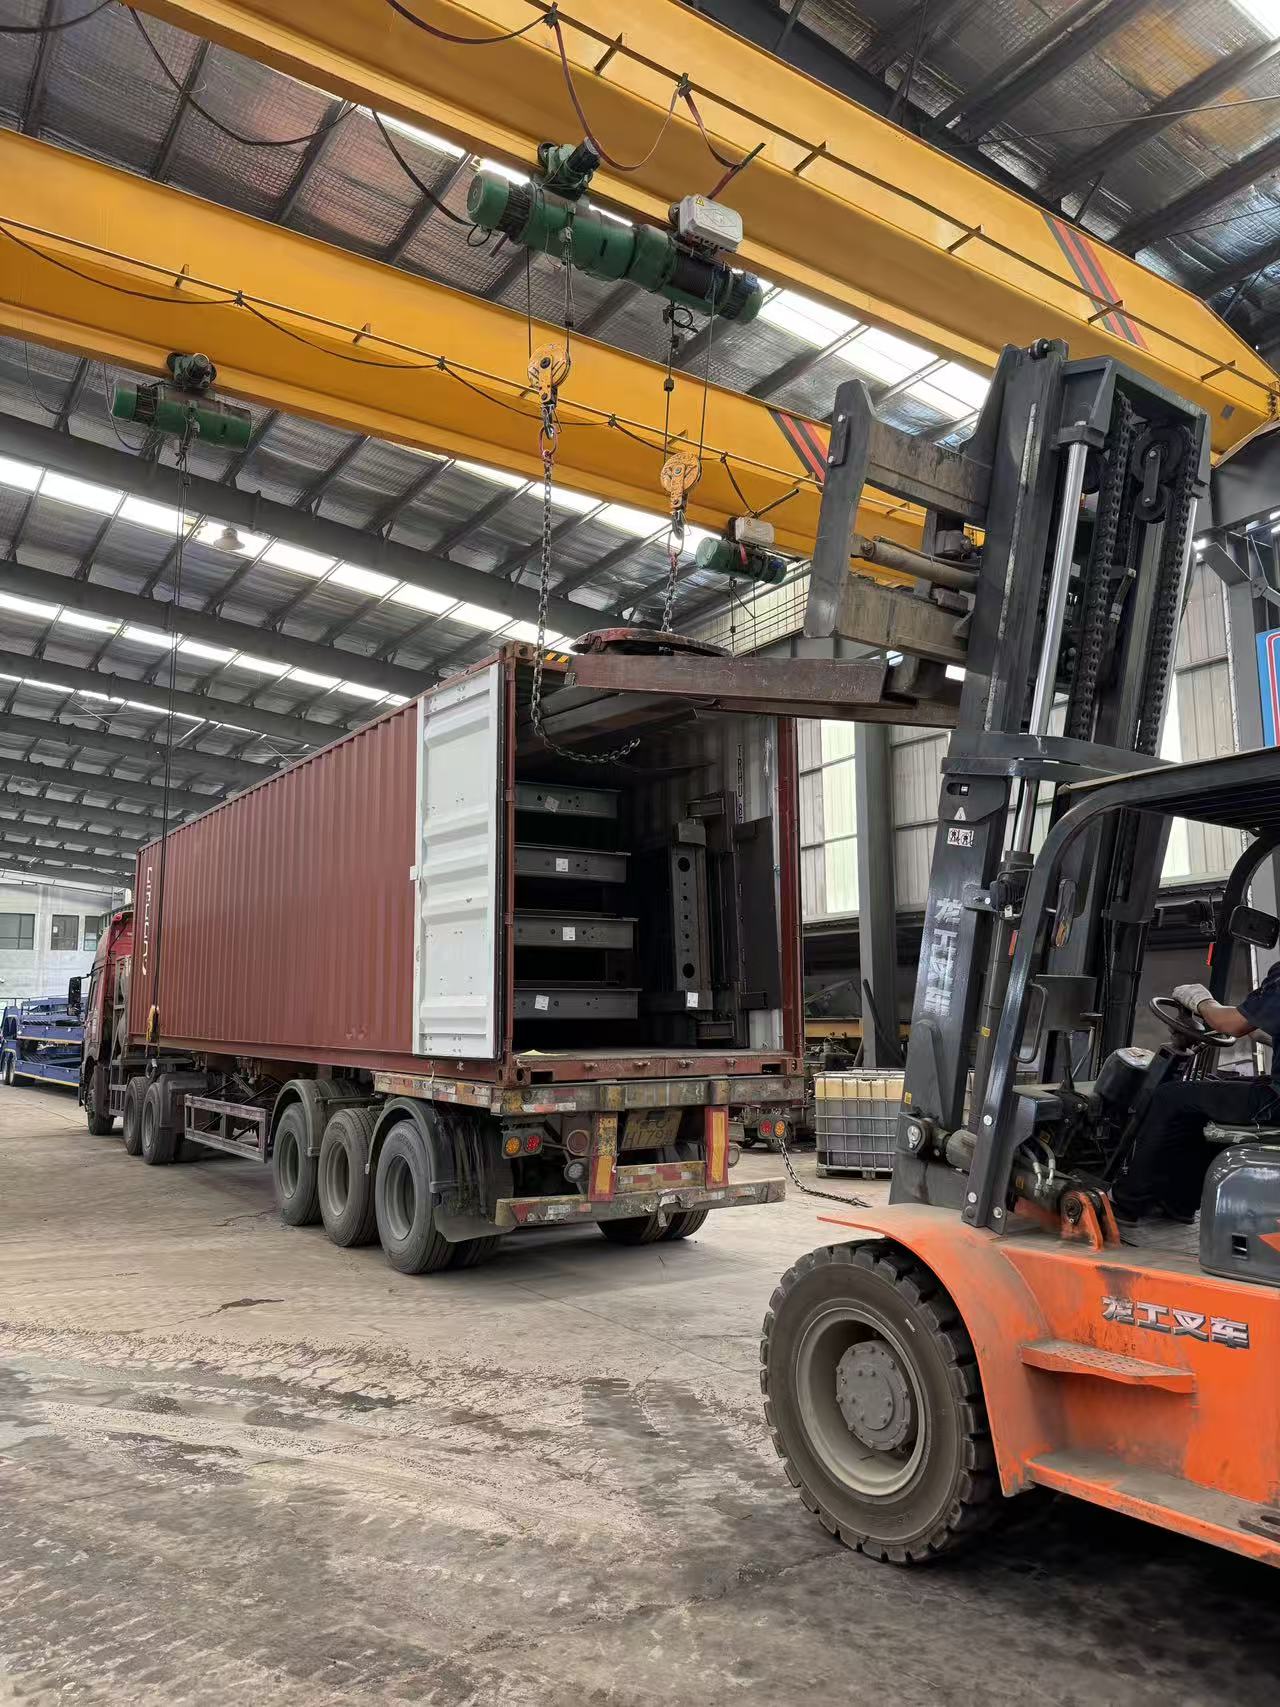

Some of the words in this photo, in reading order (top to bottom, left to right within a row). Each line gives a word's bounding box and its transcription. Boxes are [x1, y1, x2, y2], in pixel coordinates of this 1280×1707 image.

[924, 898, 962, 1017] 龙工叉车
[1101, 1296, 1250, 1350] 龙工叉车
